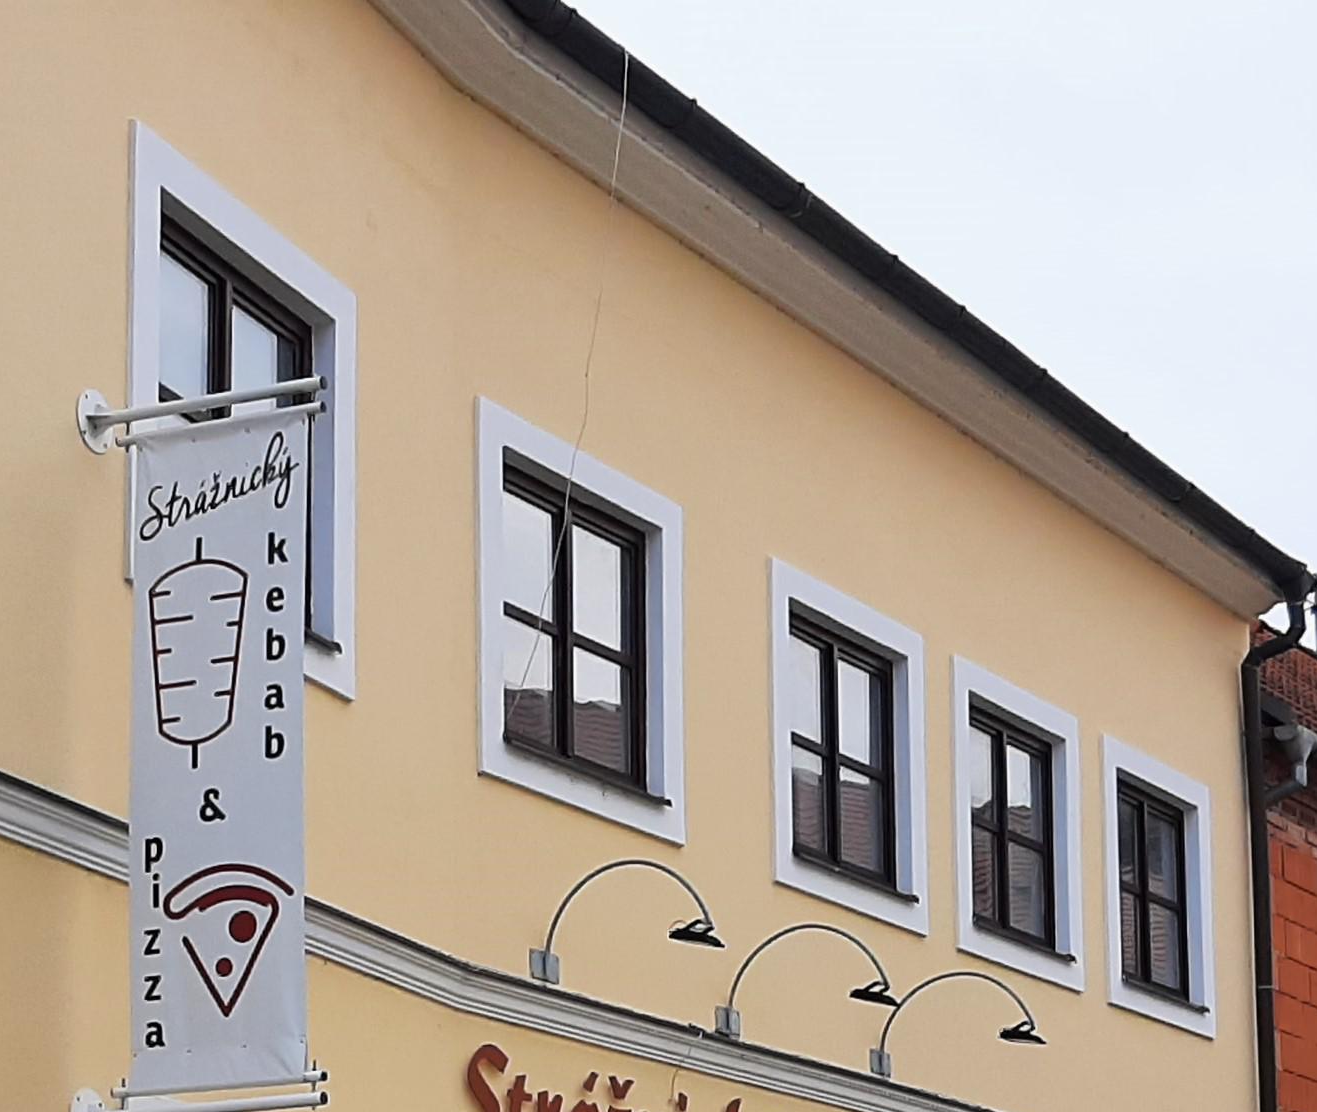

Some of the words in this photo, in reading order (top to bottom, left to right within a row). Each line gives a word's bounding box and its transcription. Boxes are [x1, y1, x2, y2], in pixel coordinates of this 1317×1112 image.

[139, 431, 300, 541] Strážnický
[265, 532, 289, 760] kebab
[199, 788, 227, 822] &
[143, 835, 166, 1049] pizza
